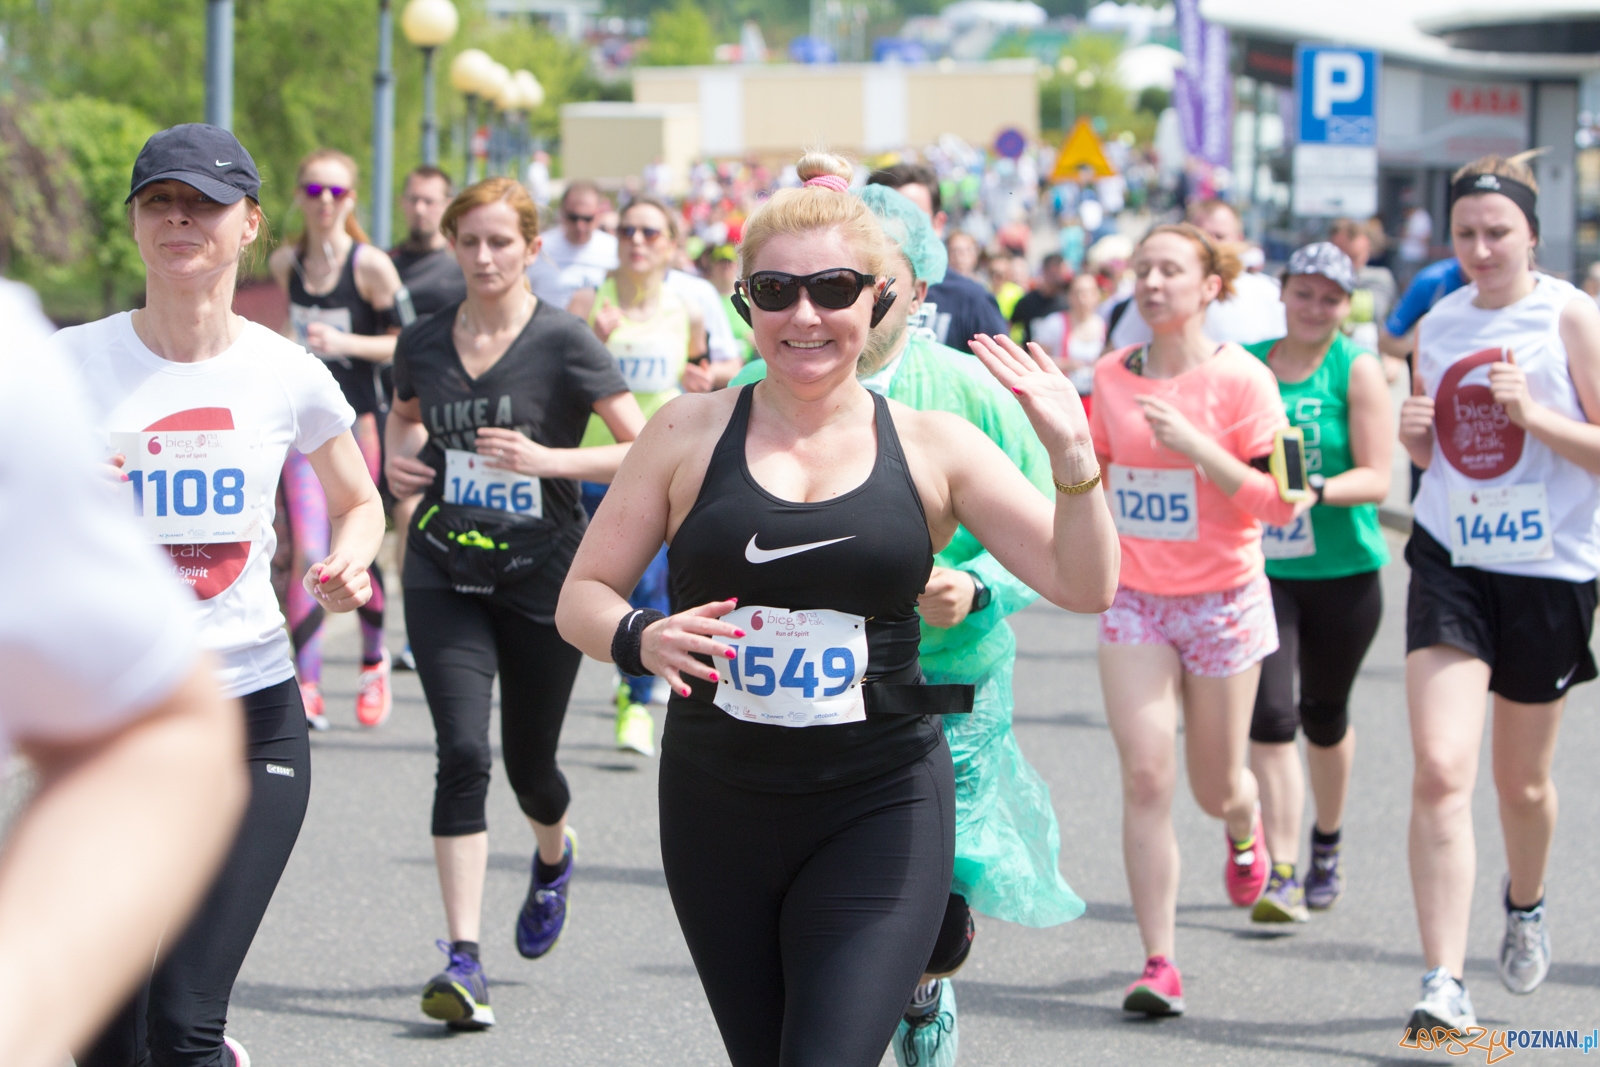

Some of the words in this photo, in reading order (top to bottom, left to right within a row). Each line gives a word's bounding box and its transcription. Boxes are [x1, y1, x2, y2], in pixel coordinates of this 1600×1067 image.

[1313, 51, 1365, 120] P
[430, 397, 490, 435] LIKE
[494, 394, 513, 426] A
[165, 434, 194, 453] bieg
[127, 468, 245, 517] 1108
[452, 477, 533, 512] 1466
[1116, 489, 1189, 522] 1205
[1455, 509, 1544, 546] 1445
[178, 565, 209, 578] Spirit
[767, 610, 795, 630] bieg
[808, 617, 825, 626] tak
[727, 644, 856, 698] 1549
